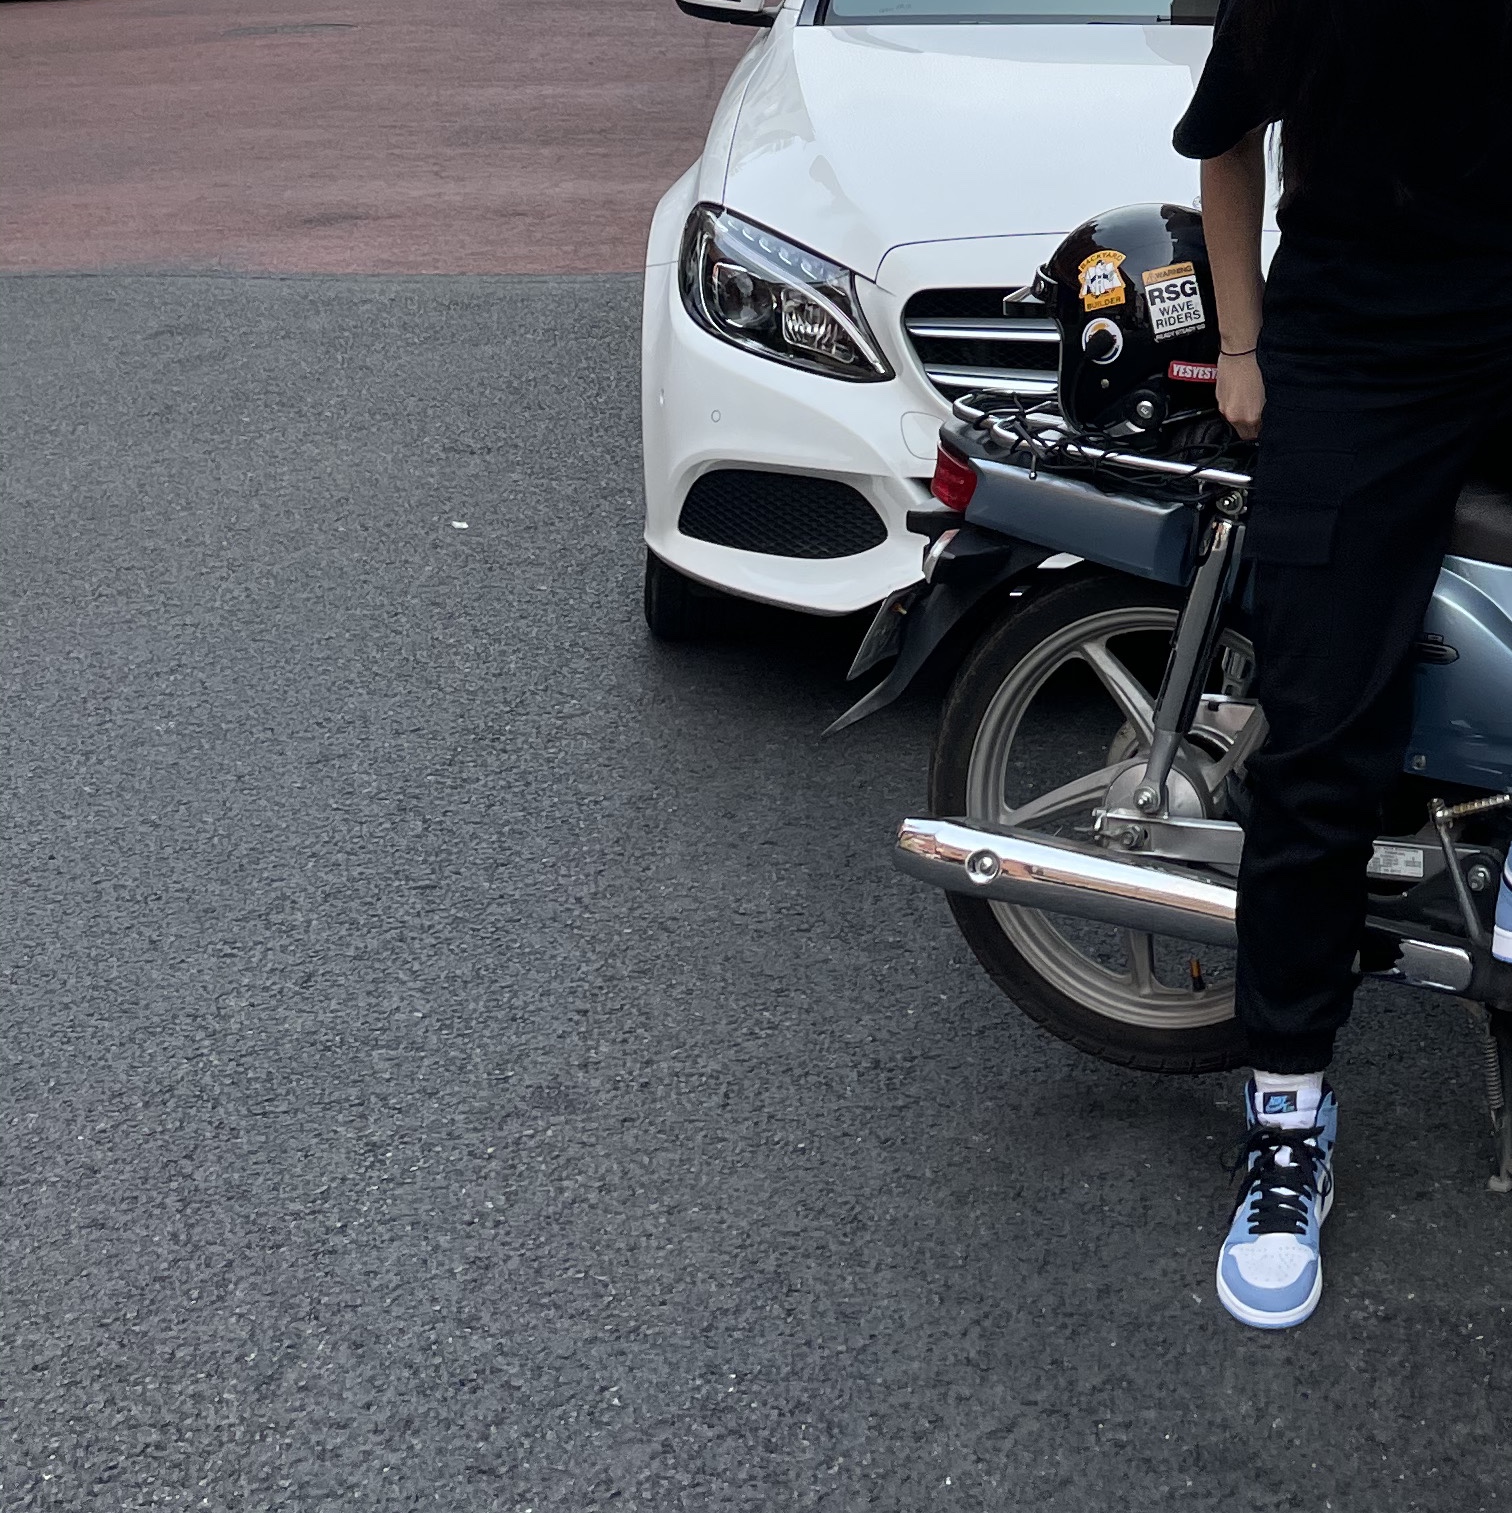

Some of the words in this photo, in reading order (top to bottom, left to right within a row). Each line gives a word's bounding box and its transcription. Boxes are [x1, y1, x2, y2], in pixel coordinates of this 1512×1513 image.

[1080, 251, 1124, 270] BACKYARD
[1147, 279, 1198, 307] RSG
[1086, 296, 1122, 311] BUILDER
[1158, 300, 1195, 317] WAVE
[1155, 309, 1201, 330] RIDERS
